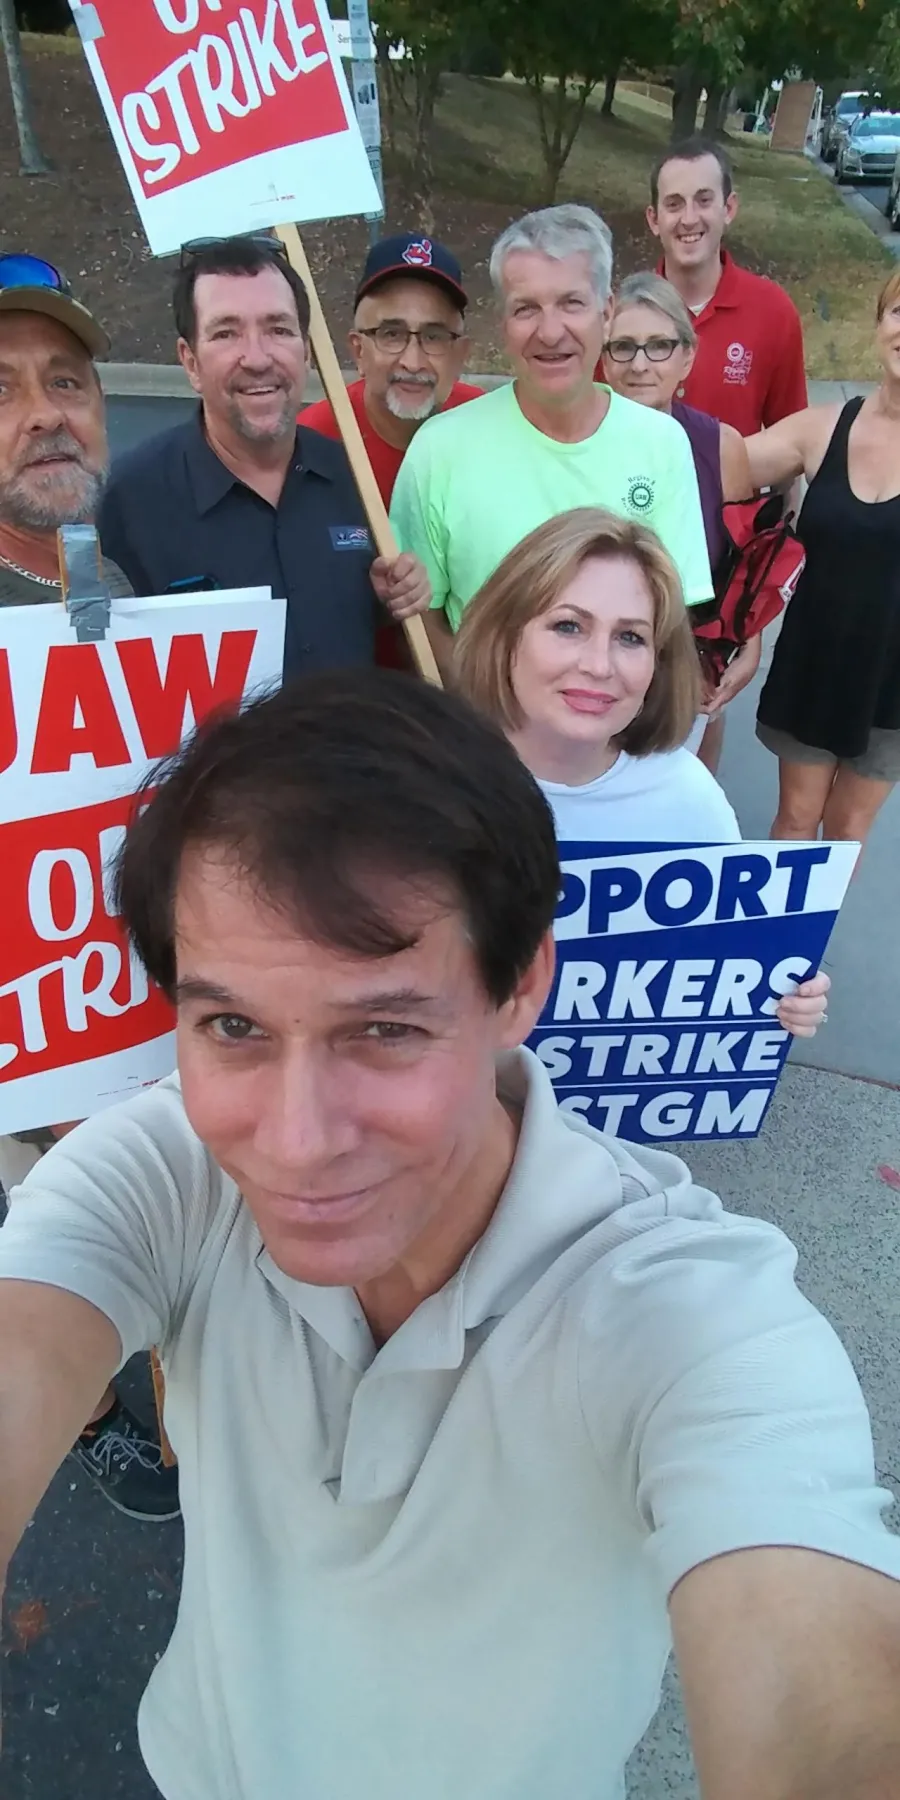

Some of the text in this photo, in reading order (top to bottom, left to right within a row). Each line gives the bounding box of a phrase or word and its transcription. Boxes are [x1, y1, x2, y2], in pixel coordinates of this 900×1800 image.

[121, 0, 328, 184] STRIKE
[535, 1030, 790, 1080] STRIKE
[640, 1088, 772, 1137] GM
